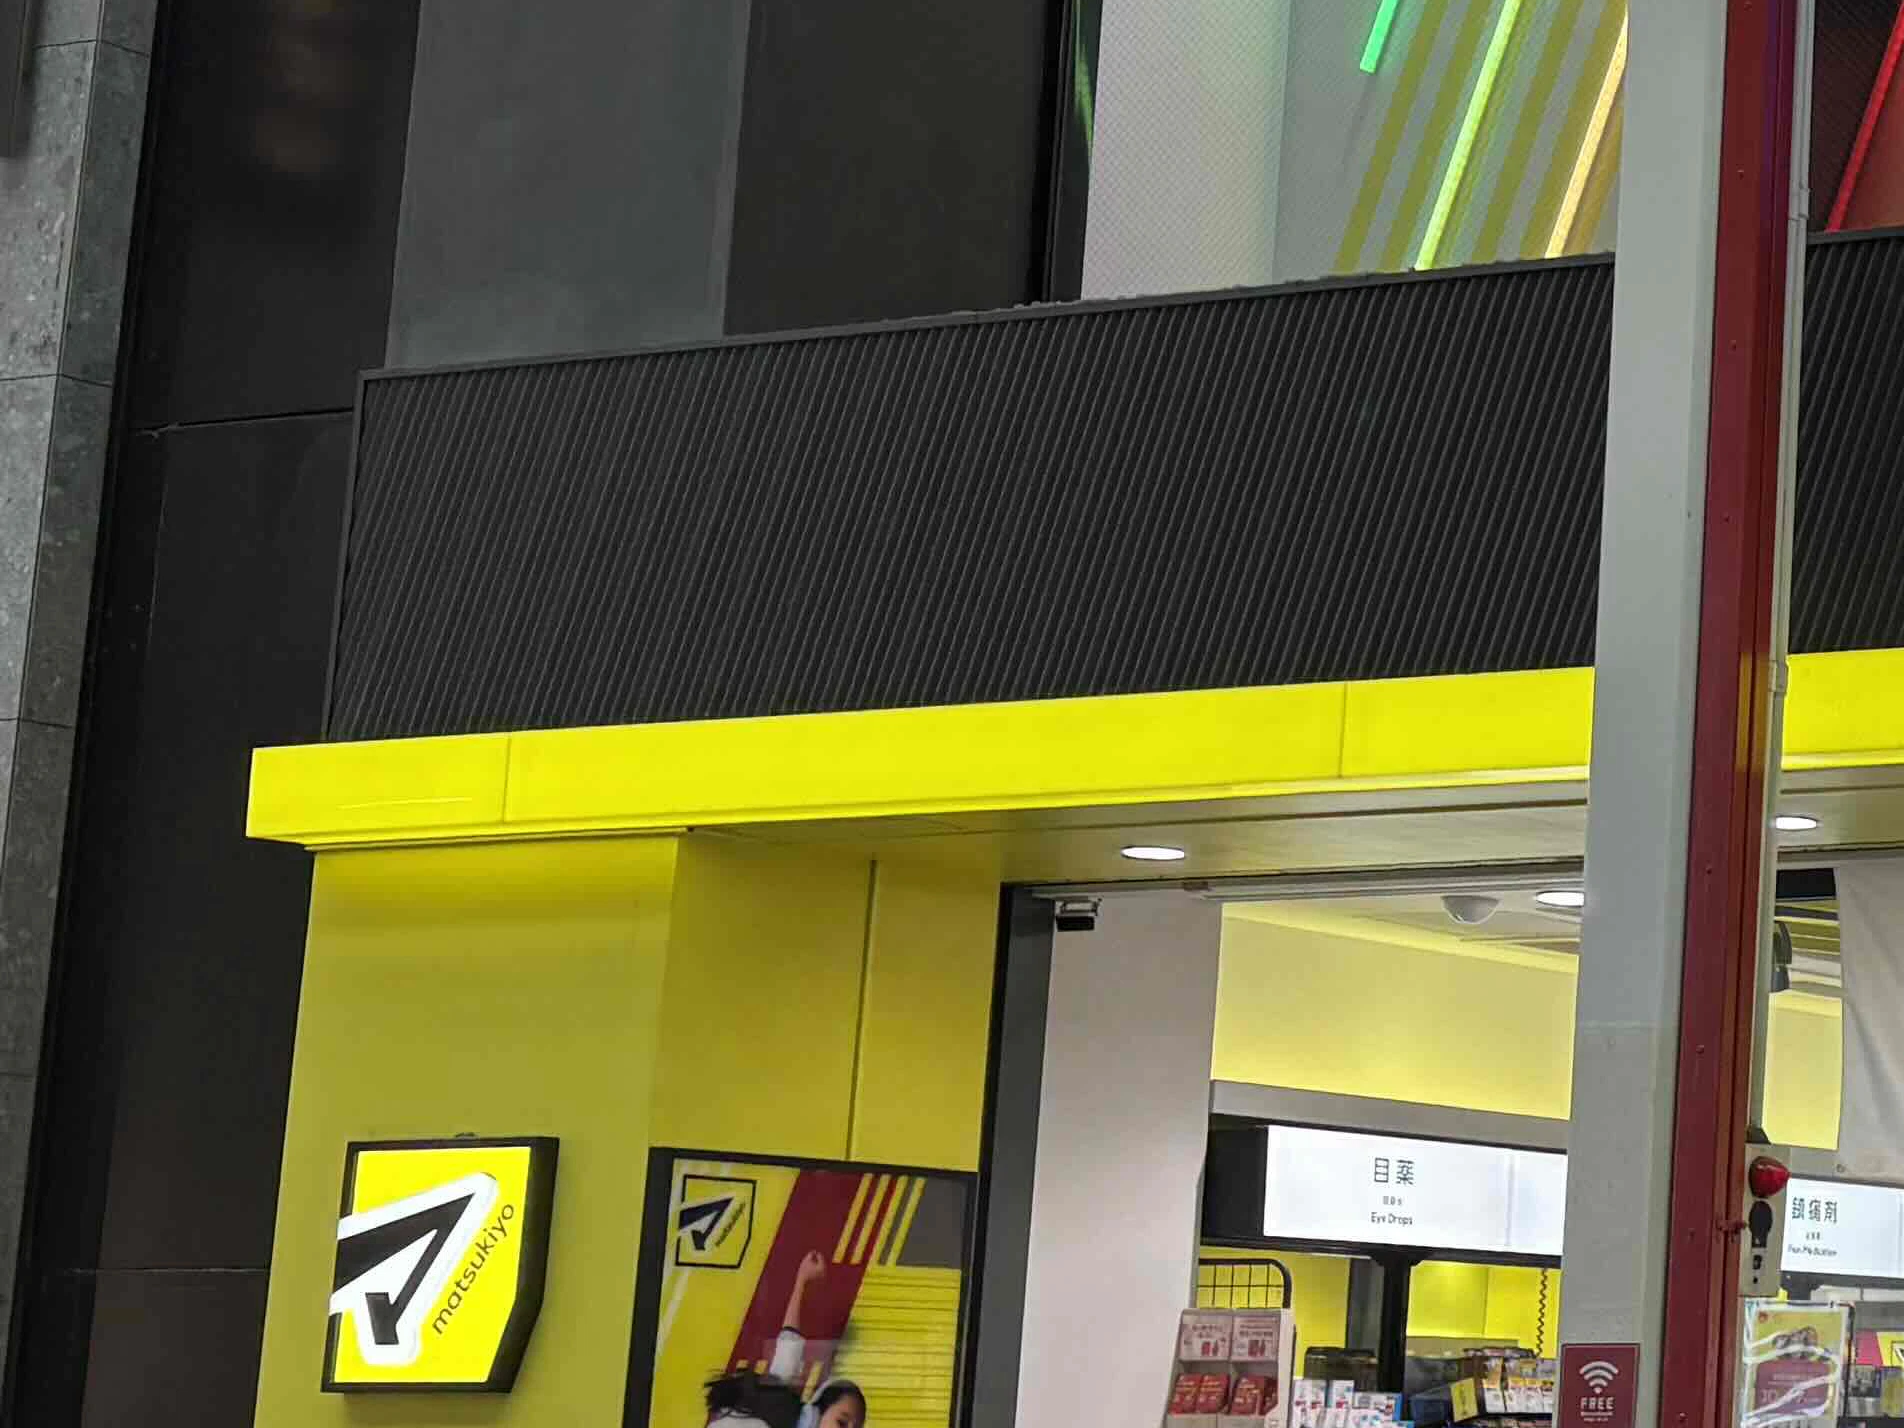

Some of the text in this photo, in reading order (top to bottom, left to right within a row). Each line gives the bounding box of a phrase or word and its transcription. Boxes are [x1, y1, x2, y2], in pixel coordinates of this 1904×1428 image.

[1373, 1157, 1415, 1185] 目薬
[431, 1202, 515, 1337] matsukiyo
[1580, 1397, 1615, 1410] FREE
